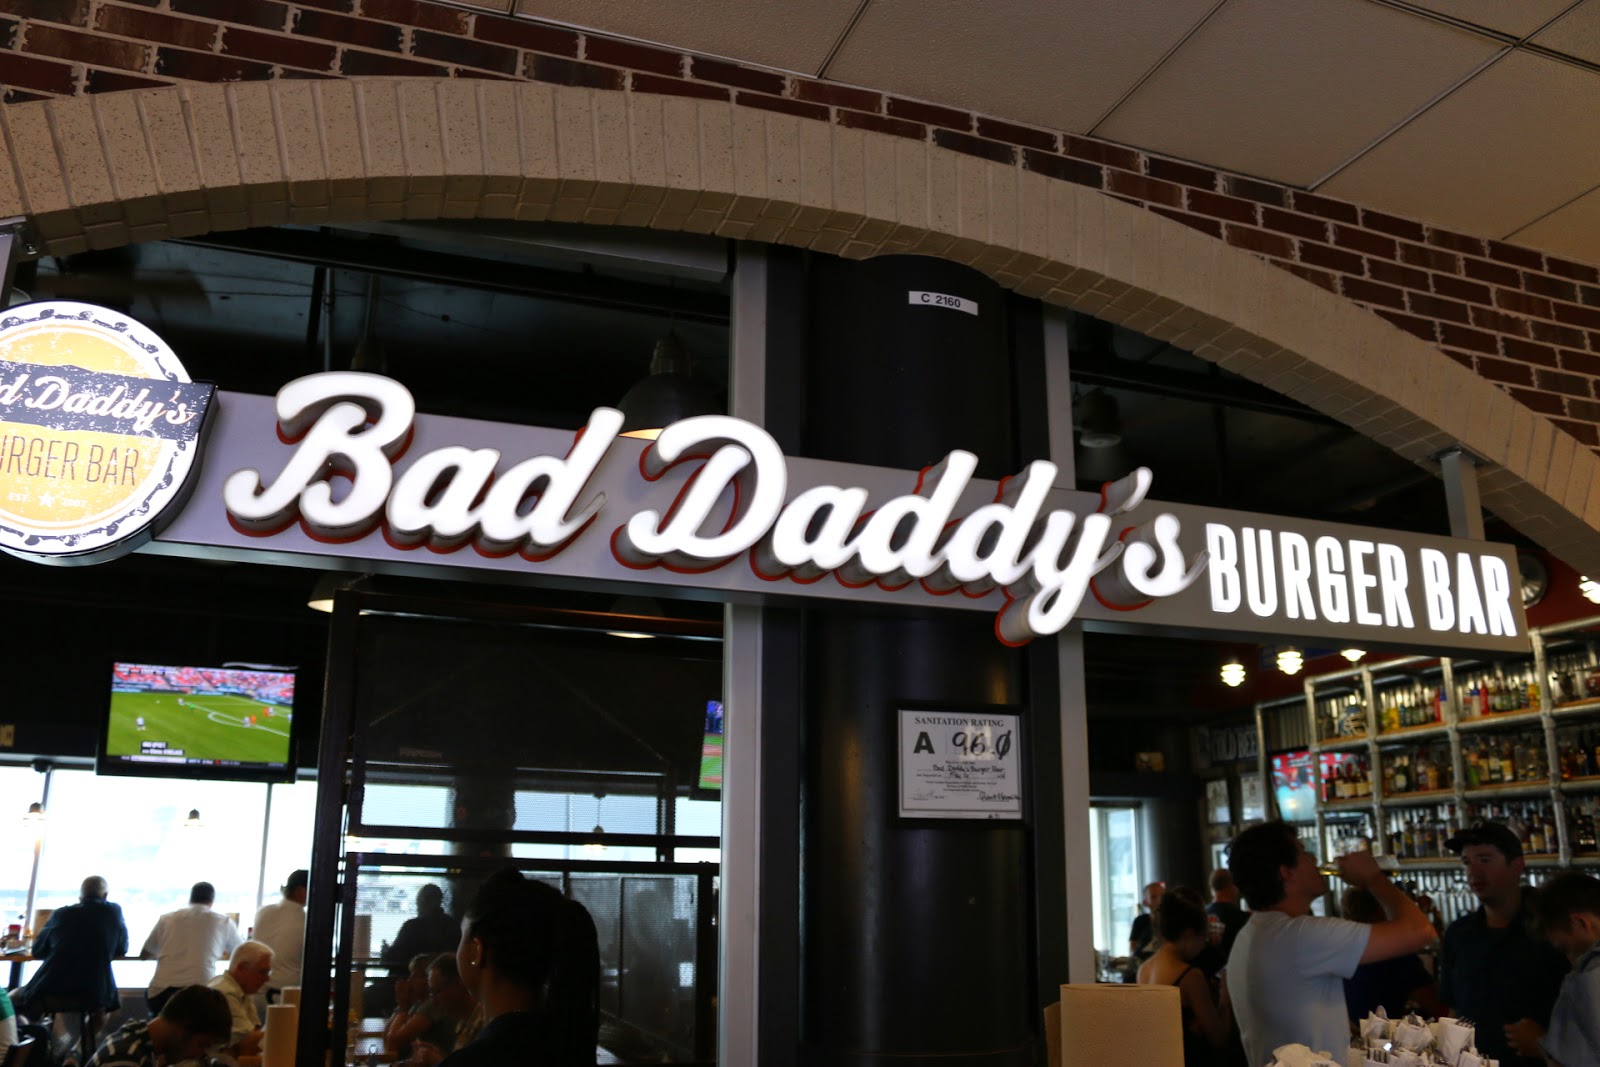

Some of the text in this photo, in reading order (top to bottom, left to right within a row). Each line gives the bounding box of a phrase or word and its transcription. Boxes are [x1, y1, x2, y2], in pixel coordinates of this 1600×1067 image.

[921, 293, 961, 308] C 2160
[24, 375, 198, 432] Daddy's
[86, 444, 139, 486] BAR
[223, 371, 1518, 637] Bad Daddy's BURGER BAR
[915, 716, 1004, 728] SANITATION RATING
[913, 731, 935, 754] A
